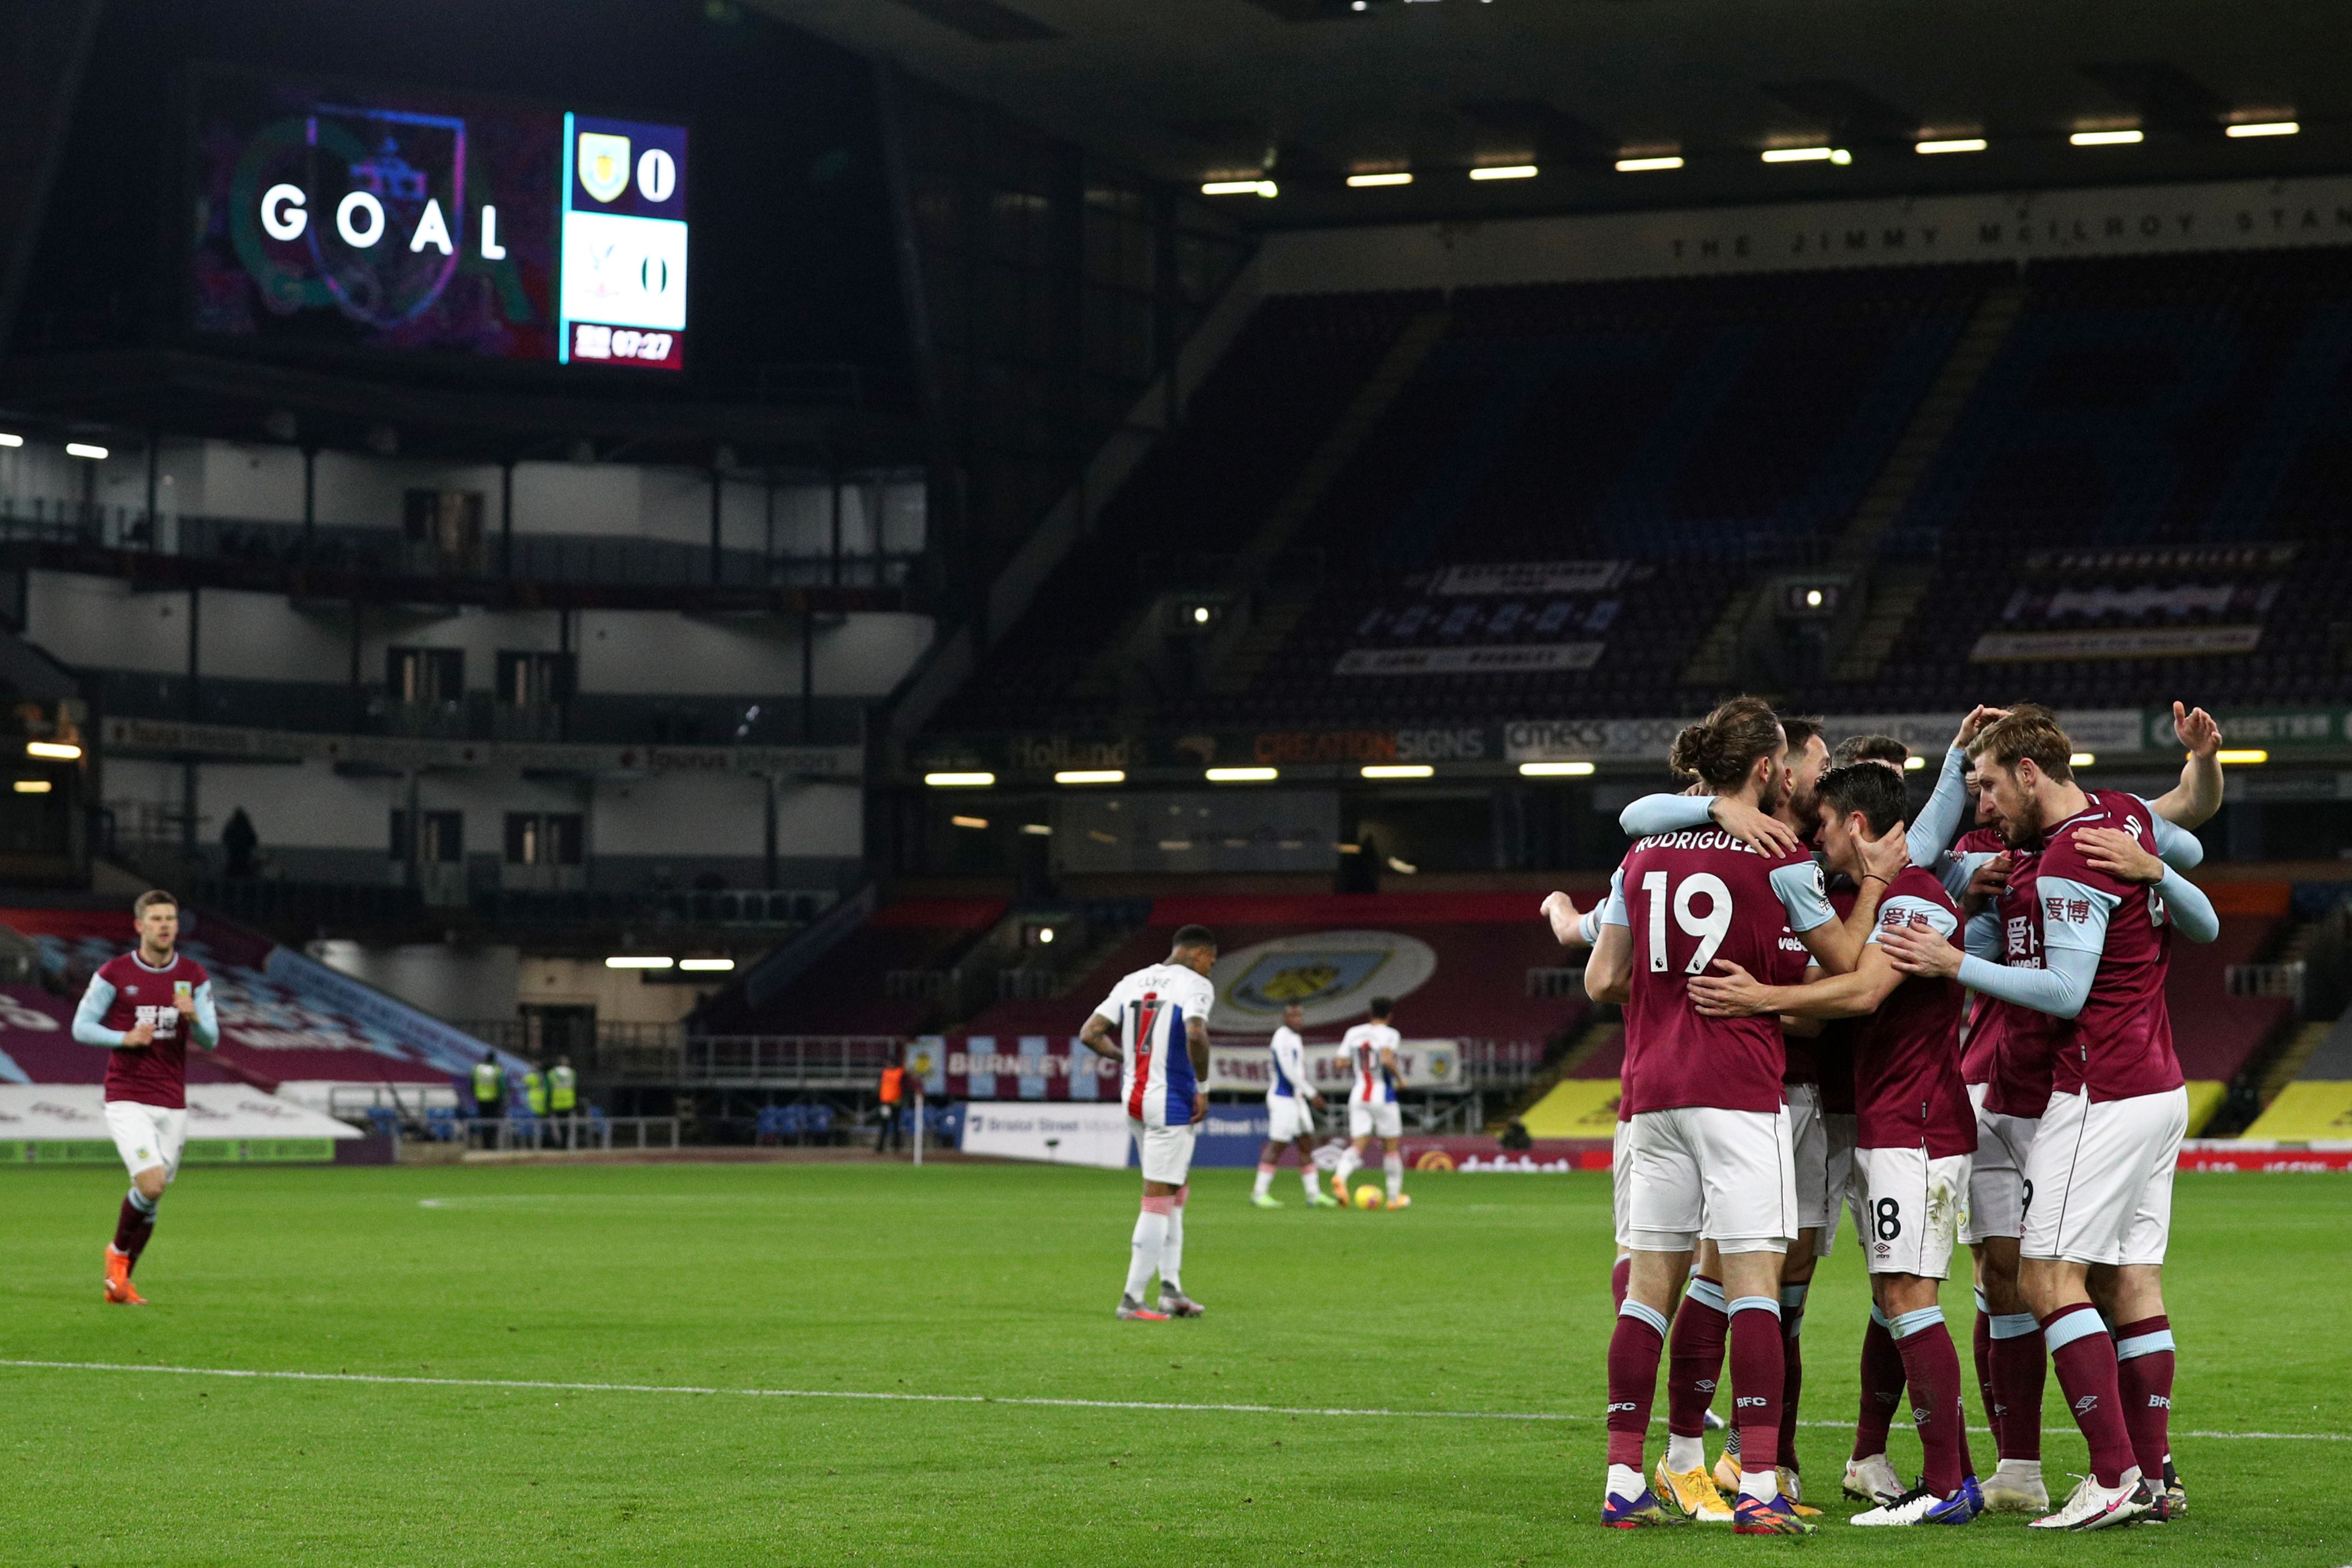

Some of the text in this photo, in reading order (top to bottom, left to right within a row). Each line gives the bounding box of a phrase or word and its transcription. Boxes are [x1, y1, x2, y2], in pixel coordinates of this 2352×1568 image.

[637, 148, 676, 202] 0
[260, 183, 506, 260] GOAL
[1671, 235, 1749, 258] THE
[1790, 228, 1938, 253] JIMMY
[1634, 830, 1758, 854] RODRIGUEZ
[1641, 870, 1733, 975] 19
[2046, 897, 2090, 925] 爱博
[1129, 999, 1167, 1055] 17
[948, 1052, 1117, 1079] BURNLEY FC
[2021, 1178, 2034, 1222] 9
[1869, 1197, 1902, 1242] 18
[1607, 1402, 1636, 1413] BFC
[1736, 1396, 1767, 1408] BFC
[2148, 1394, 2171, 1410] BFC
